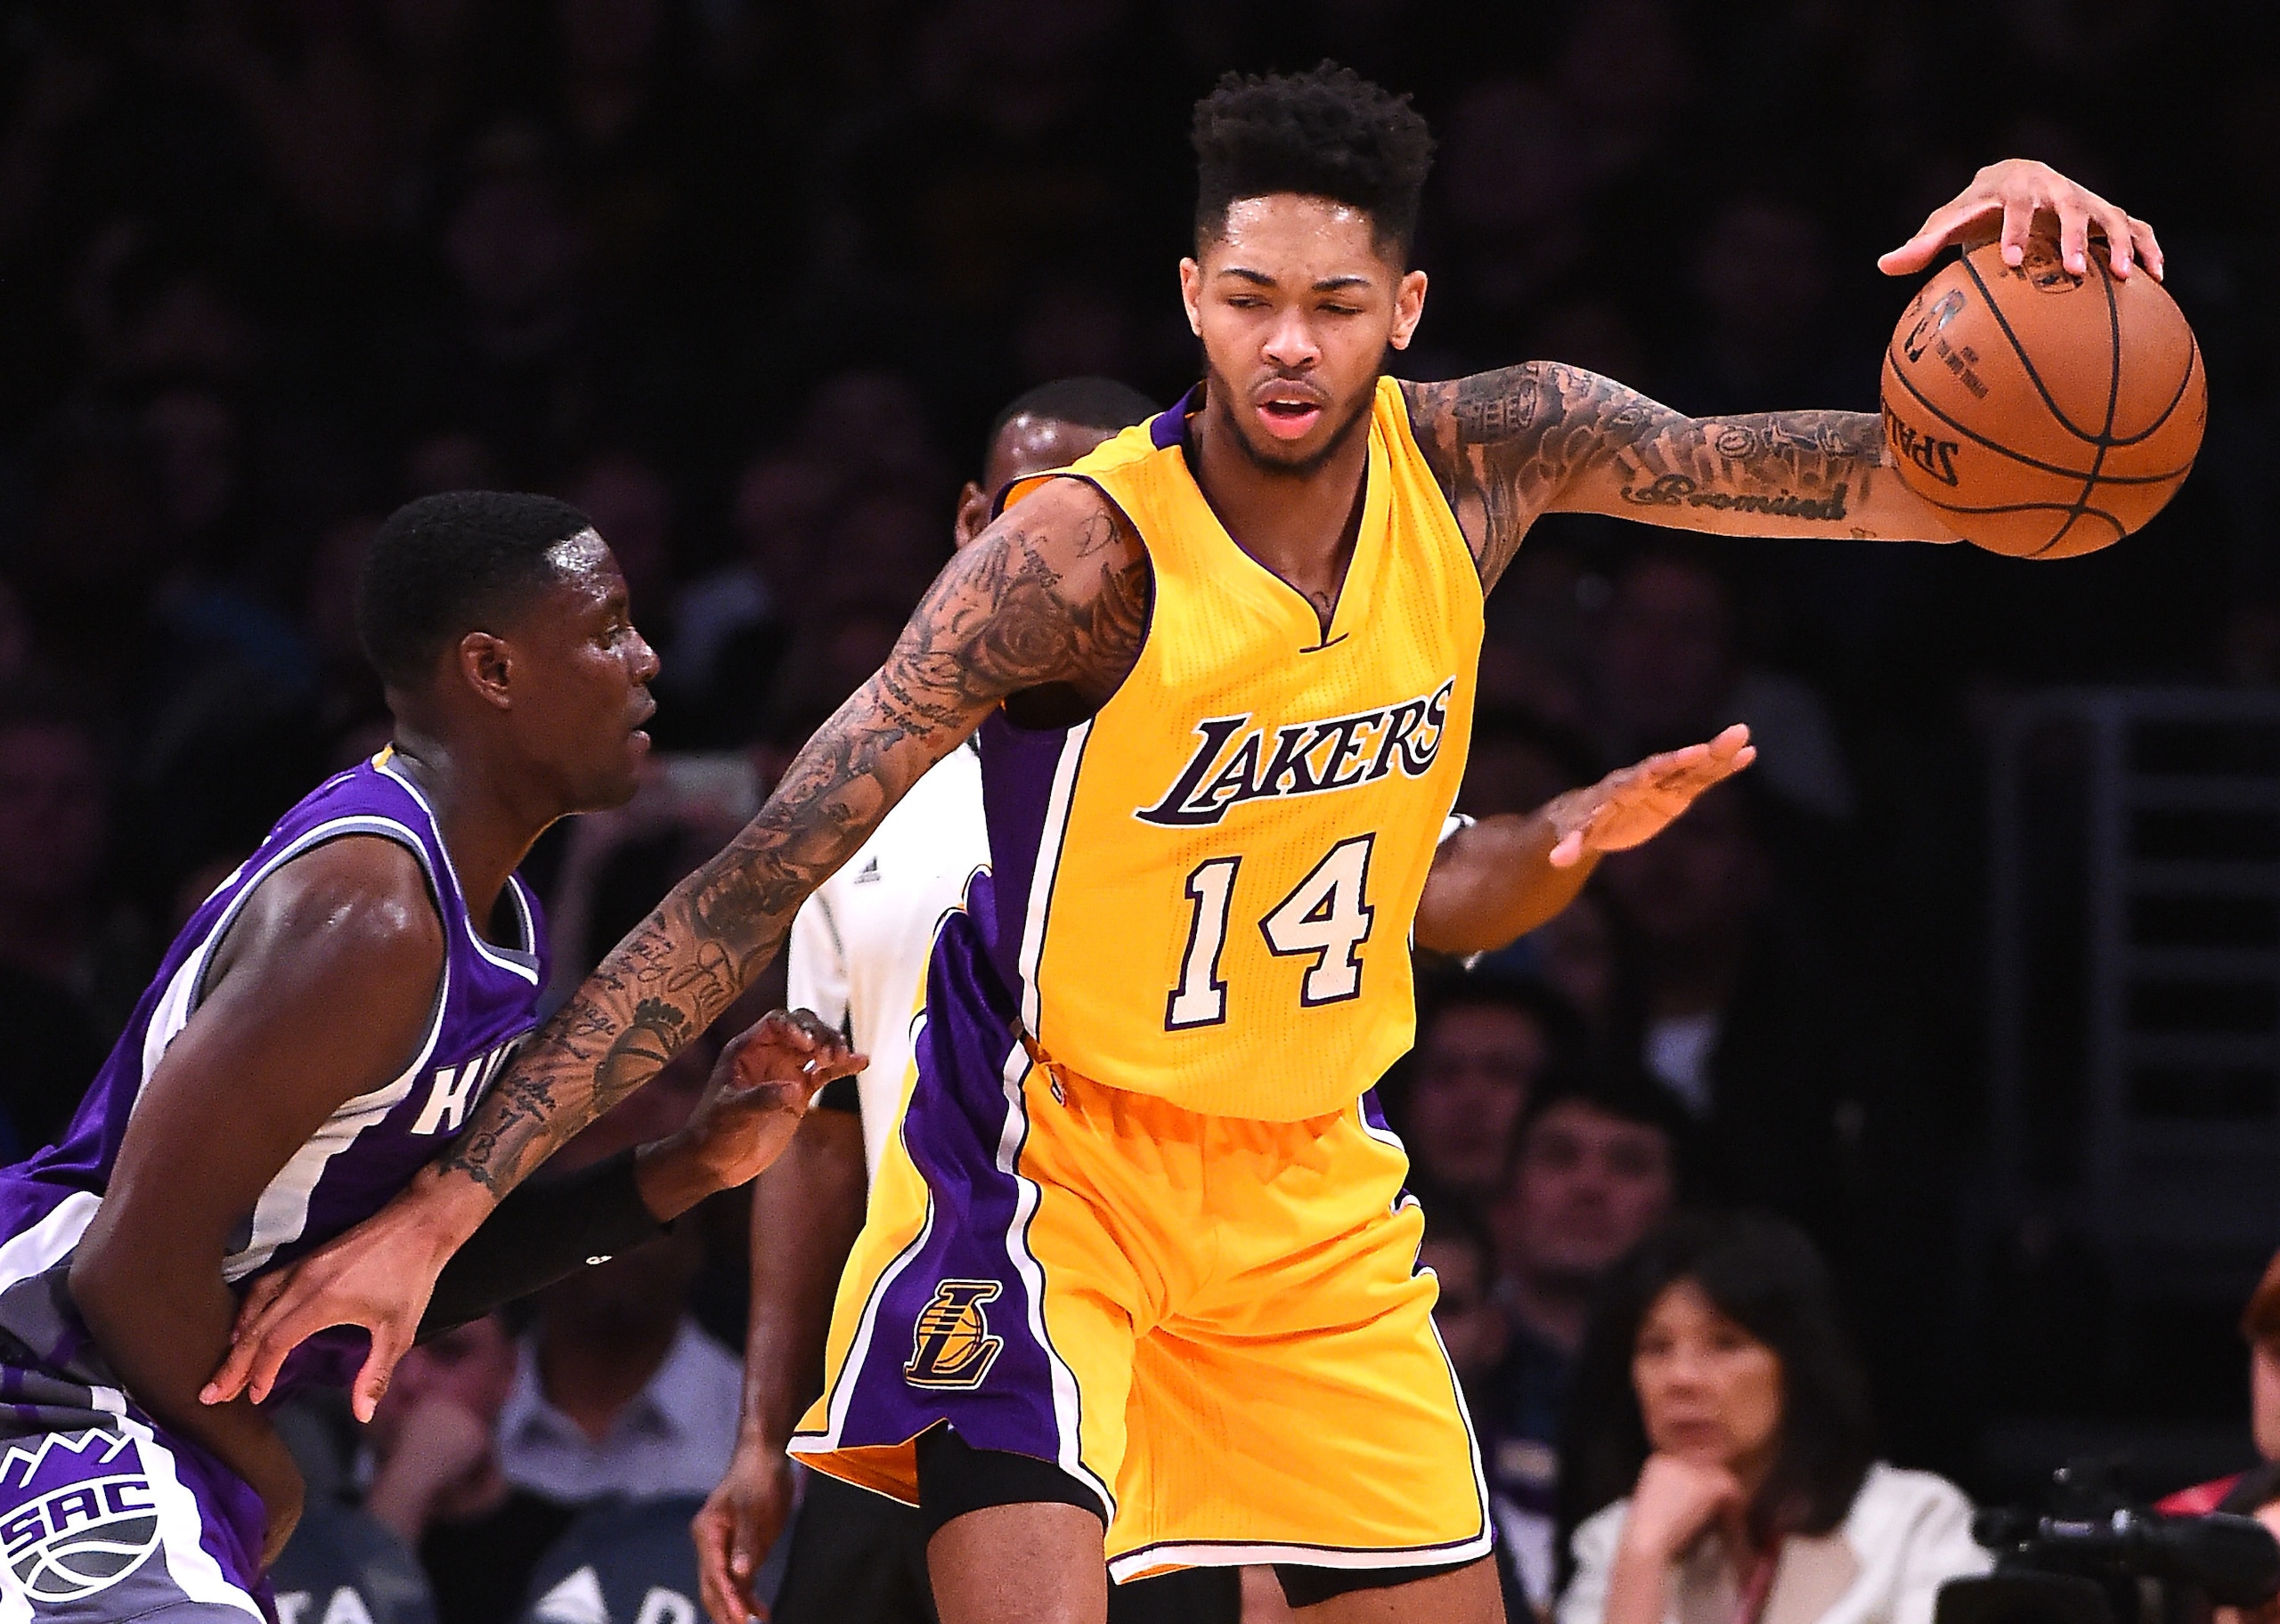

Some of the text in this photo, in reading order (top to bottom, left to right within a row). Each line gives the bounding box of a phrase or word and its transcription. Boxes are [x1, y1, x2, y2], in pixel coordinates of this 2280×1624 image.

[1882, 395, 1958, 486] SPAL
[1131, 674, 1456, 829] LAKERS
[1164, 832, 1377, 1032] 14
[0, 1481, 156, 1559] SAC
